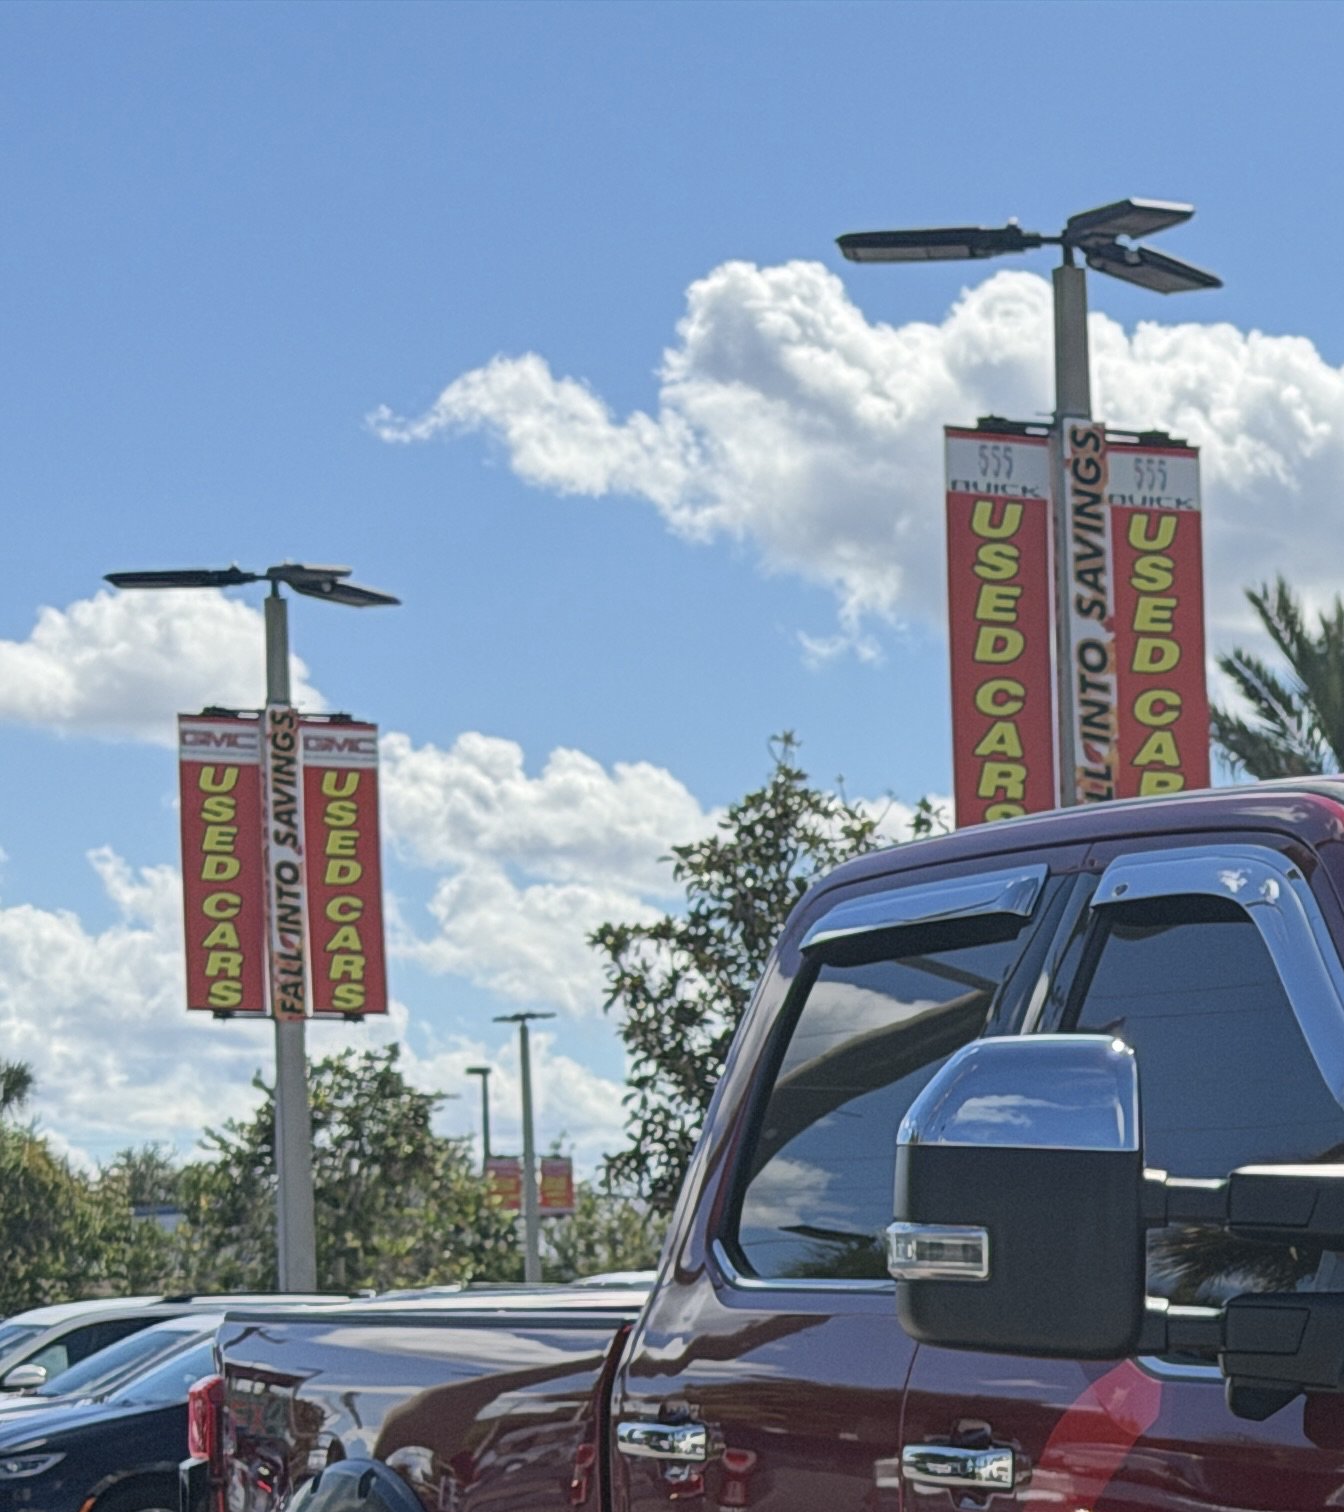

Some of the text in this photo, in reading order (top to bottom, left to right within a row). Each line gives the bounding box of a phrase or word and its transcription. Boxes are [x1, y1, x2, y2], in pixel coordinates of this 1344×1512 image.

[970, 501, 1026, 664] USED
[1071, 428, 1107, 622] SAVINGS
[1078, 638, 1111, 743] INTO
[1128, 513, 1184, 796] USED CAR
[181, 730, 258, 749] GMC
[303, 735, 378, 753] GMC
[198, 766, 242, 881] USED
[270, 709, 304, 1015] FALL INTO SAVINGS
[321, 770, 363, 886] USED
[202, 891, 244, 1008] CARS
[324, 895, 367, 1010] CARS
